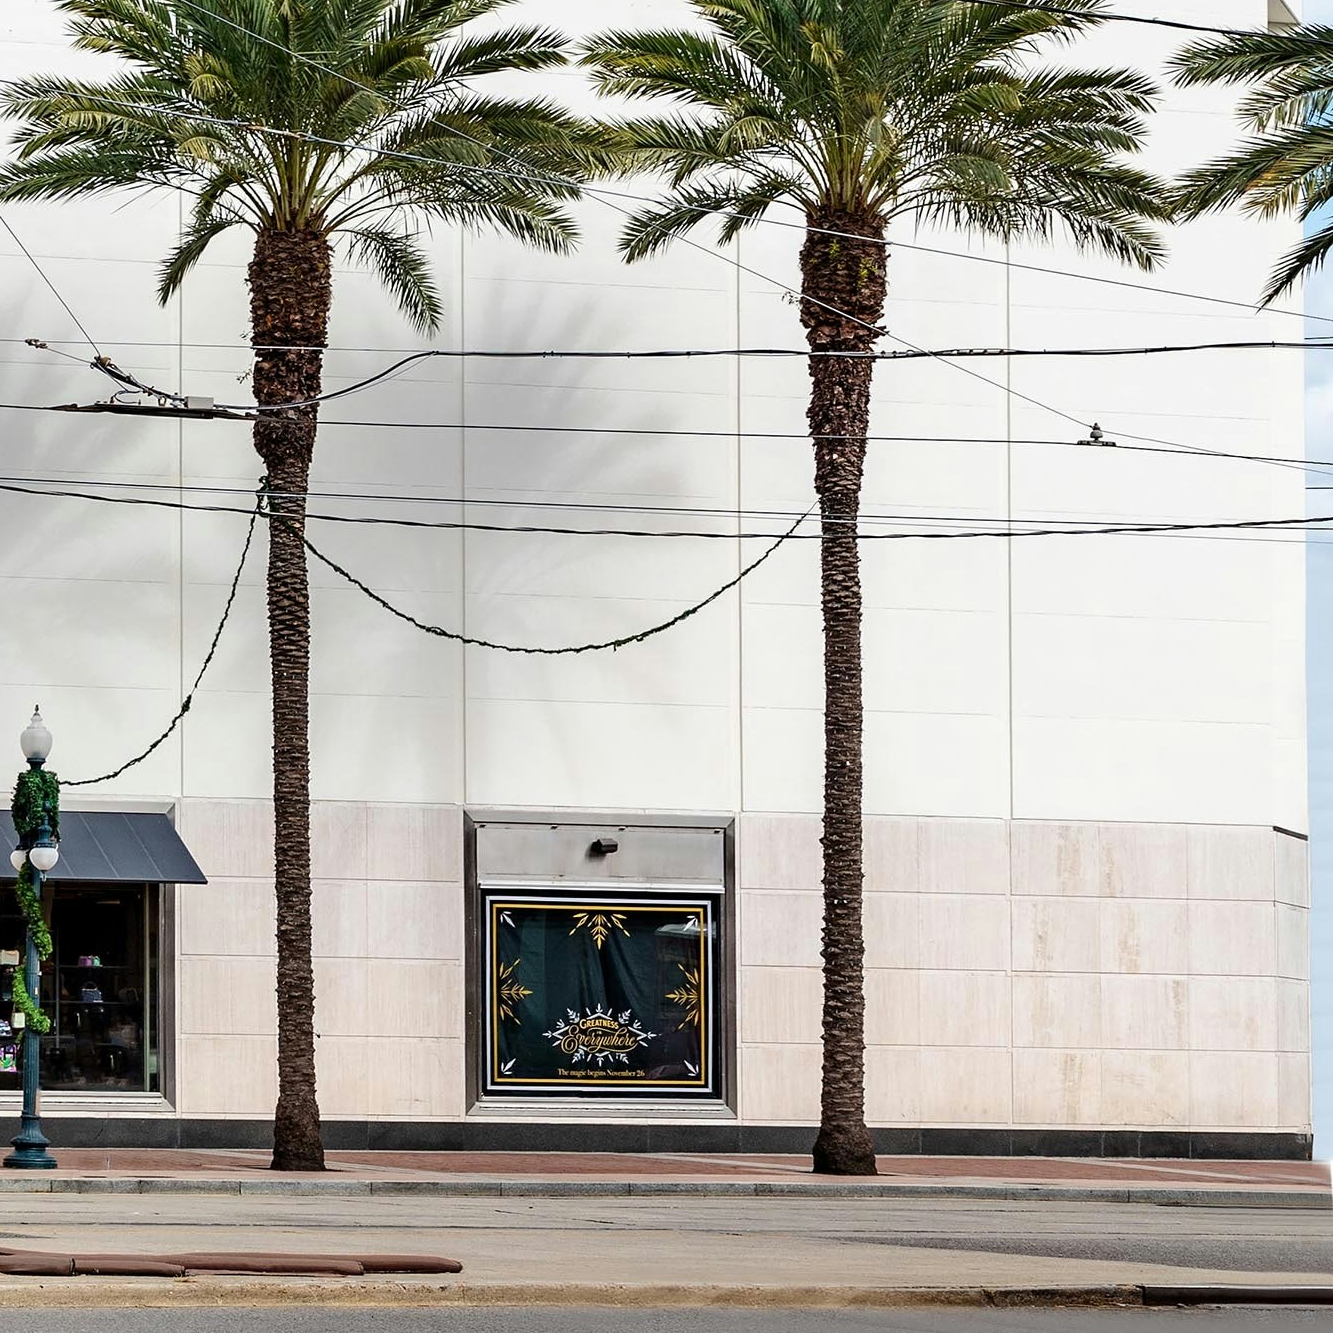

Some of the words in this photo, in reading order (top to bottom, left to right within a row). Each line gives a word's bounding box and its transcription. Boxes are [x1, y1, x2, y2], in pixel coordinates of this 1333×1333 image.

[579, 1018, 619, 1030] GREATNESS
[561, 1025, 638, 1054] Everywhere
[557, 1068, 569, 1076] The
[587, 1069, 606, 1078] begins
[607, 1069, 636, 1077] November
[636, 1069, 645, 1077] 26
